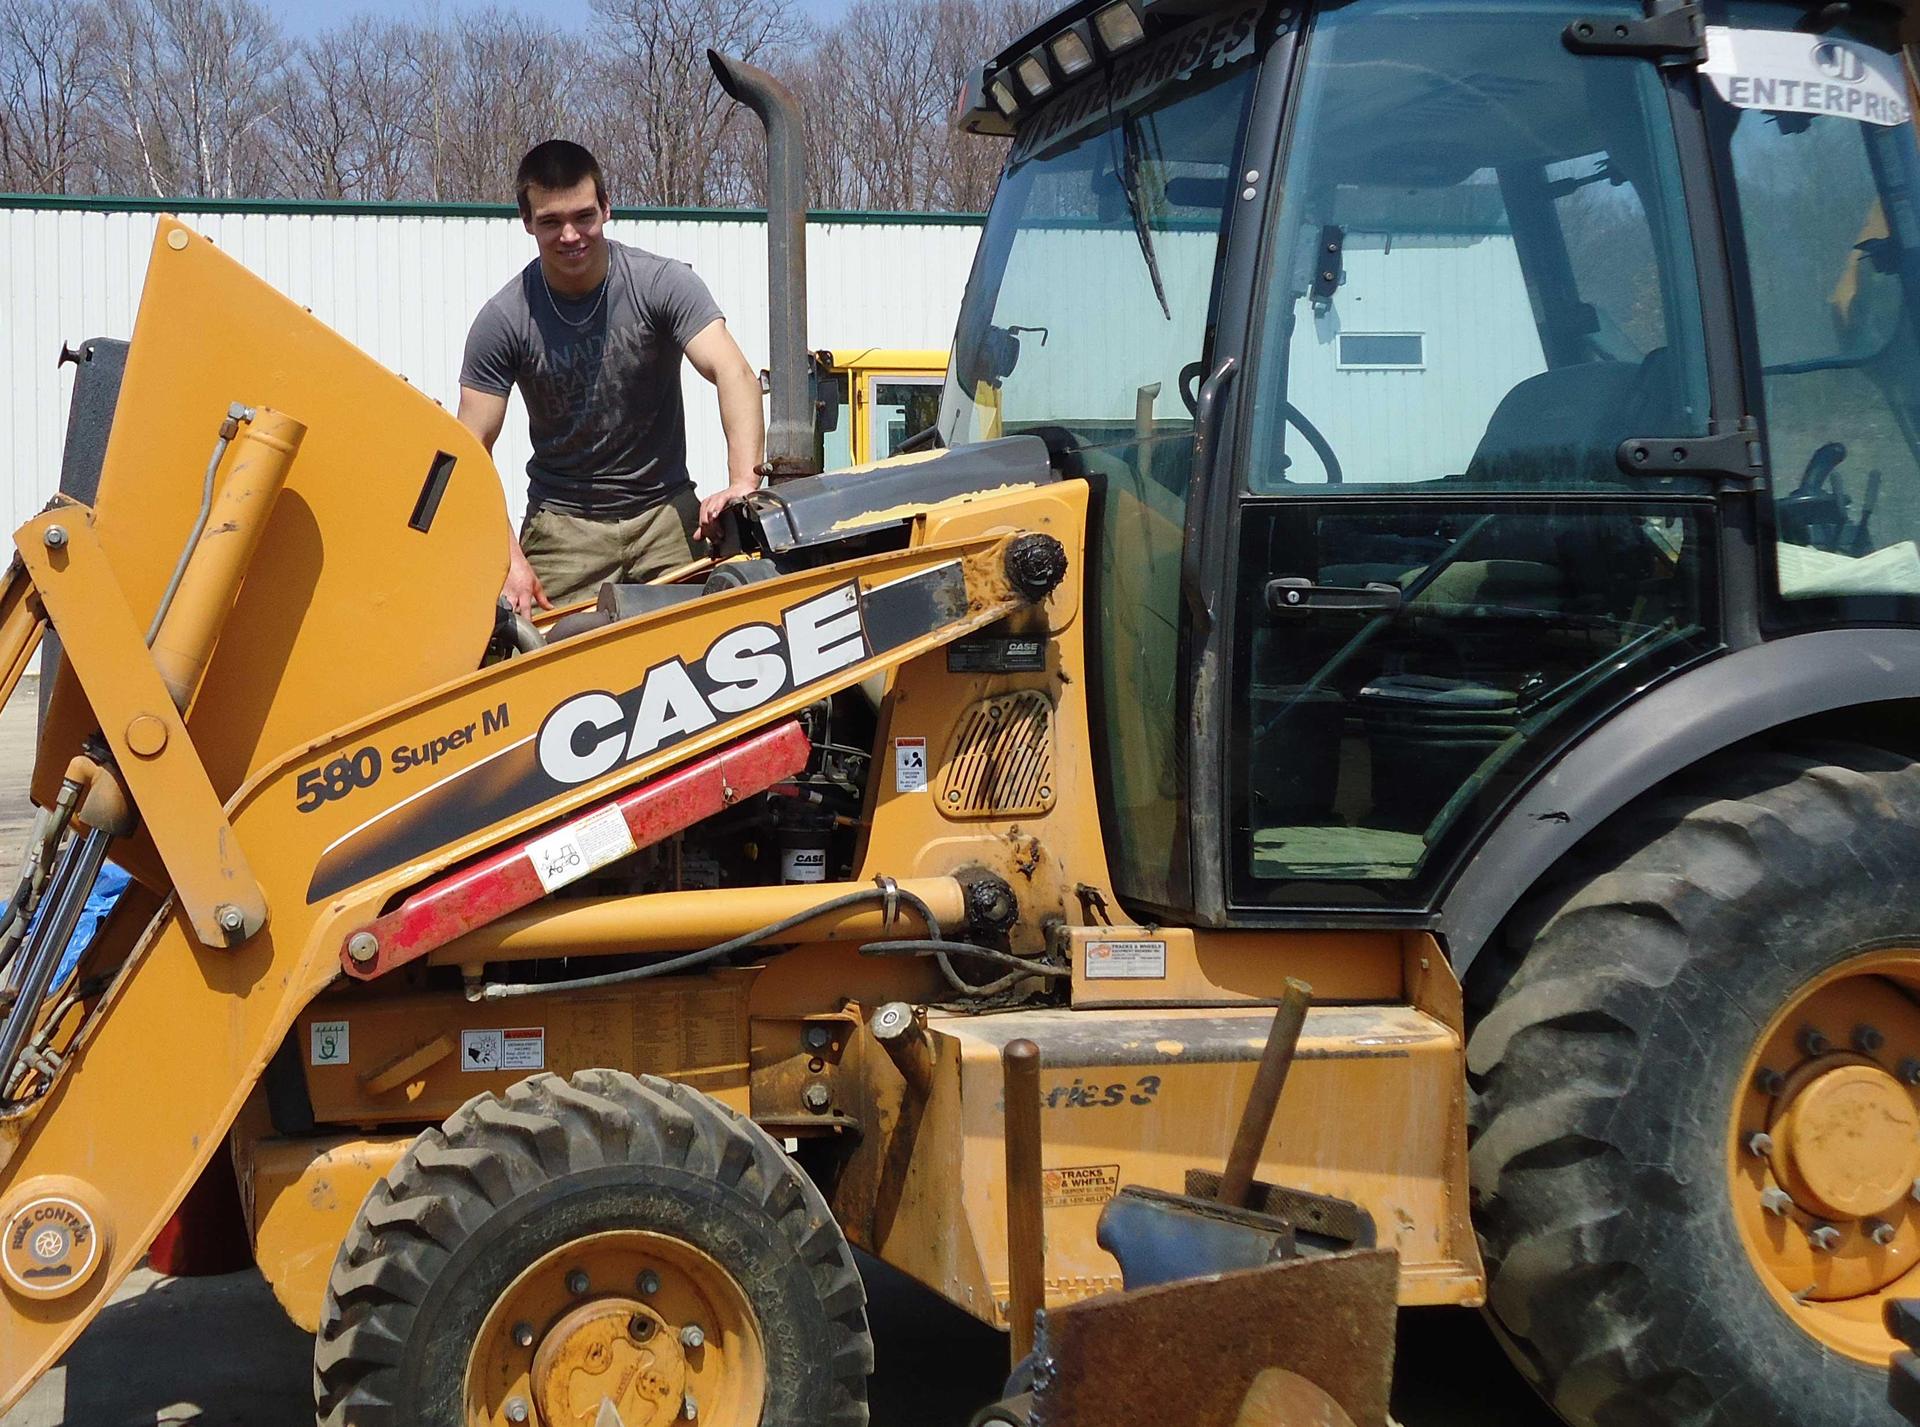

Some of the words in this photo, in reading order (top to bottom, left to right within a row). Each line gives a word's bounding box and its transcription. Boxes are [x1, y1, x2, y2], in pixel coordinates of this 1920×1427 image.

[1008, 642, 1039, 651] CASE
[537, 581, 867, 785] CASE
[295, 745, 382, 814] 580
[391, 721, 477, 774] Super
[481, 703, 511, 738] M
[795, 854, 825, 863] CASE
[997, 1078, 1127, 1111] ries
[1130, 1075, 1161, 1106] 3
[1061, 1169, 1103, 1179] TRACKS
[1061, 1180, 1068, 1188] &
[1071, 1177, 1116, 1187] WHEELS
[34, 1207, 86, 1247] CONTROL
